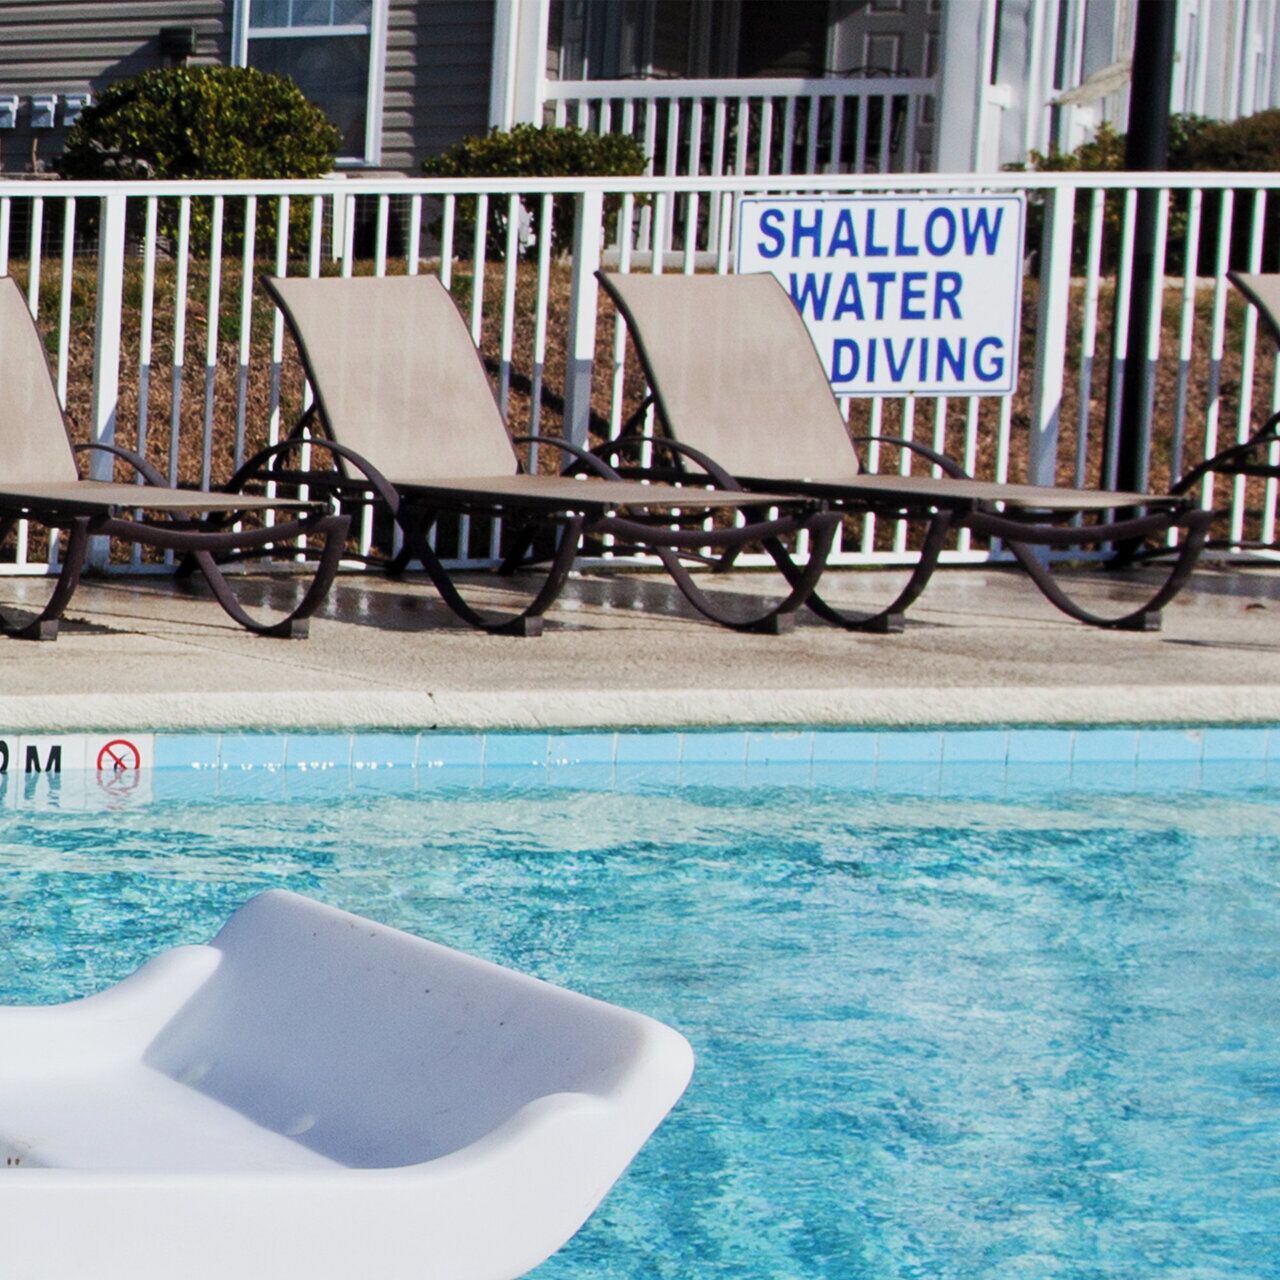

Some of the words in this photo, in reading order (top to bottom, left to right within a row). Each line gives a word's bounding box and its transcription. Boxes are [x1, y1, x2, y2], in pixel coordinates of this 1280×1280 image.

[757, 207, 1004, 258] SHALLOW
[790, 271, 963, 321] WATER
[830, 337, 1005, 383] DIVING
[25, 745, 62, 773] M
